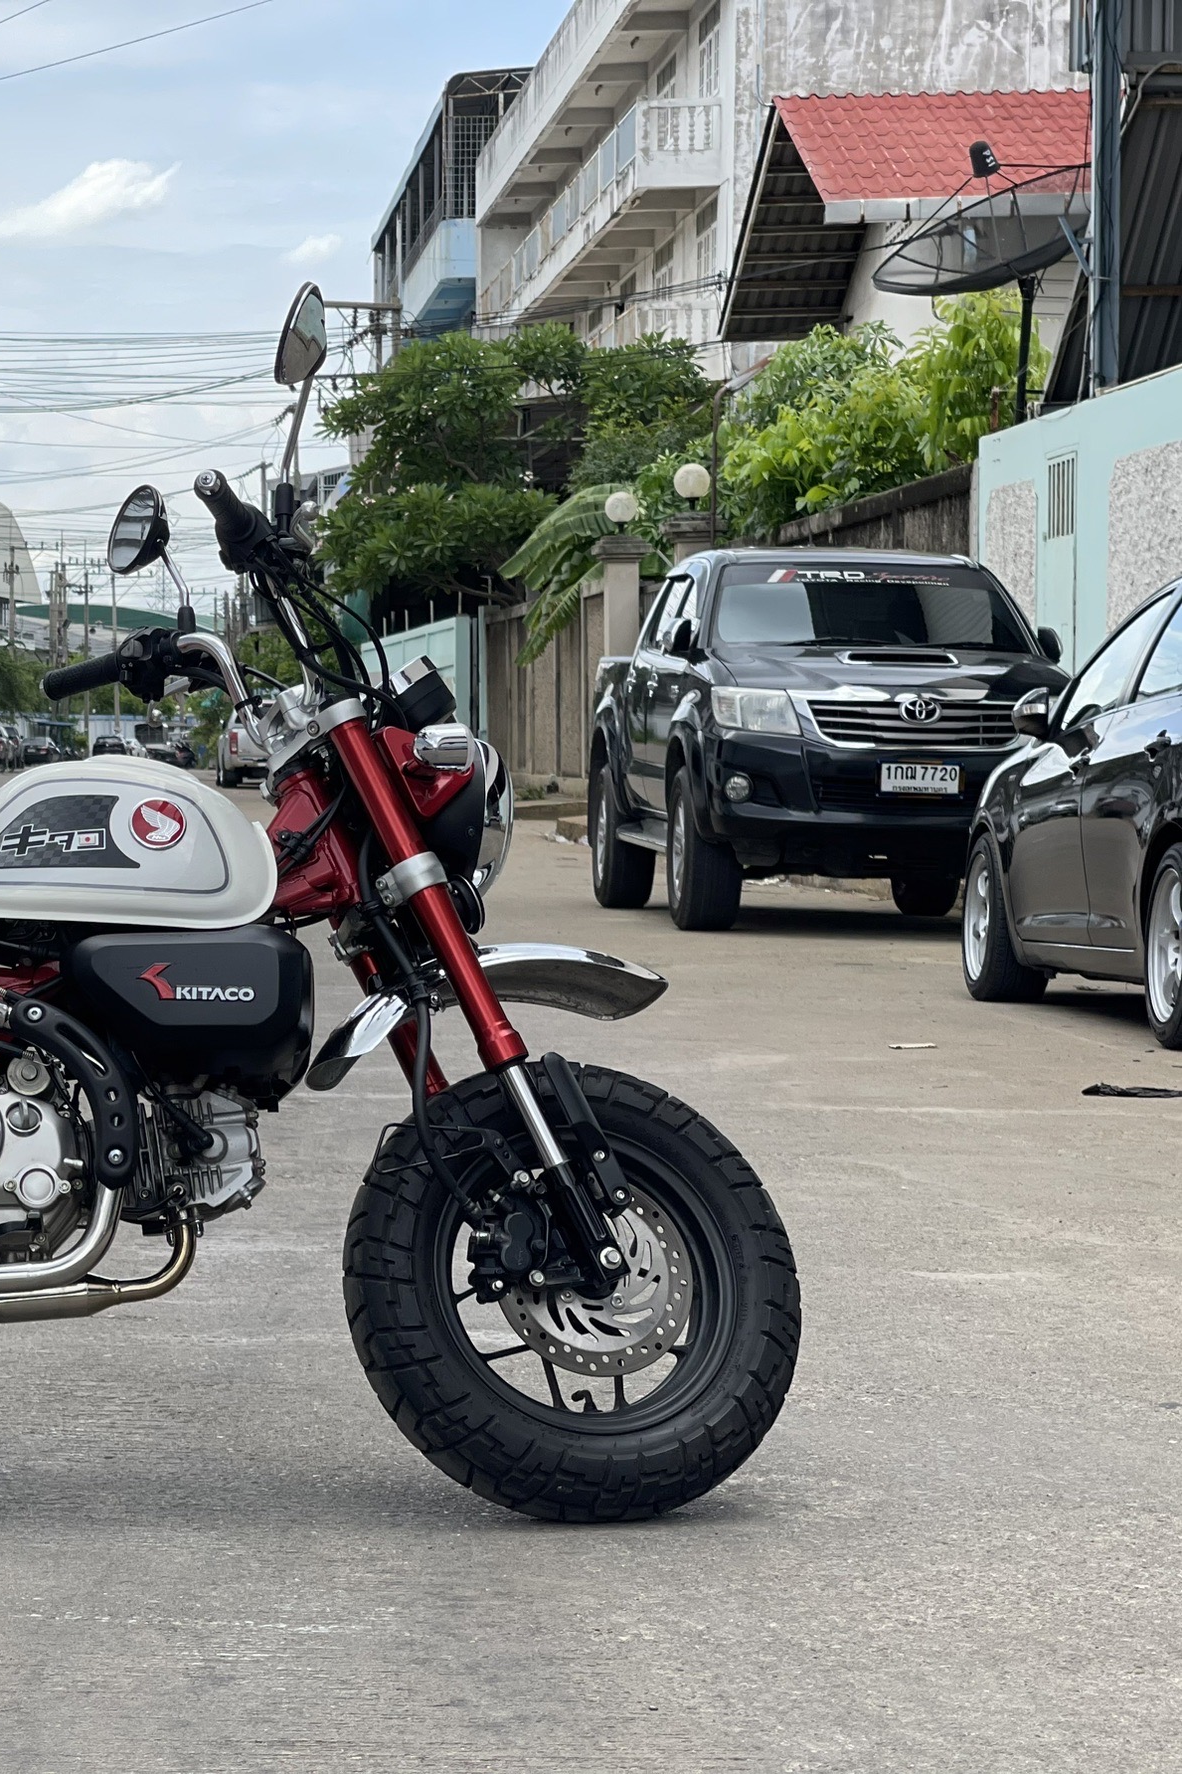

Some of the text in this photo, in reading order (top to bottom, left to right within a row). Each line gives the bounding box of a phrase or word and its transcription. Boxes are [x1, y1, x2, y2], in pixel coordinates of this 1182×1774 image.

[982, 149, 996, 167] PSI
[797, 570, 866, 580] TRD
[920, 766, 958, 782] 7720
[175, 986, 256, 1002] KITACO
